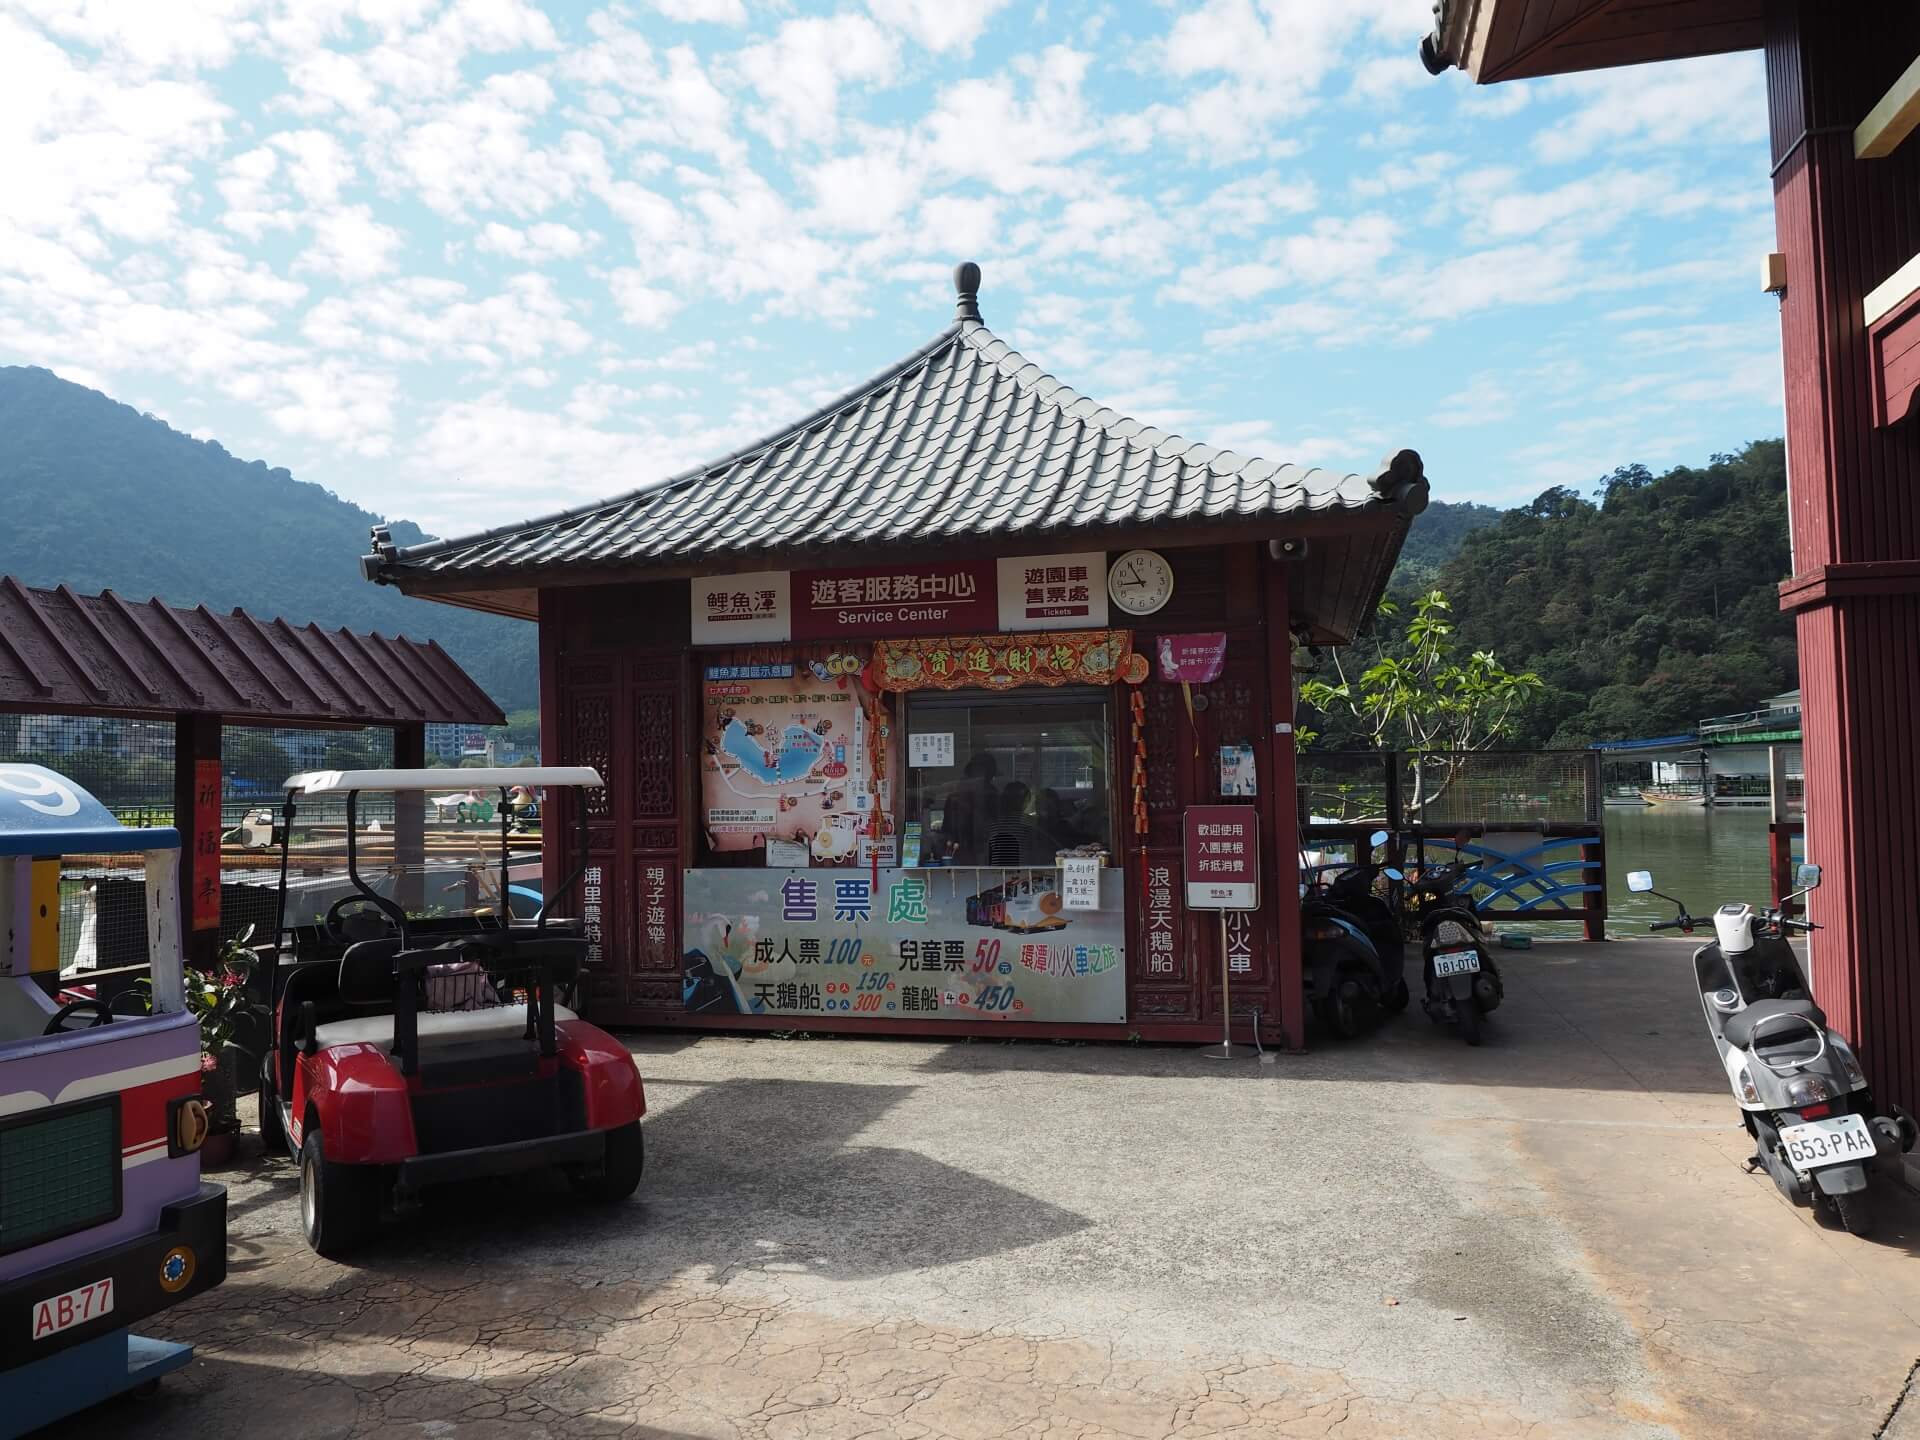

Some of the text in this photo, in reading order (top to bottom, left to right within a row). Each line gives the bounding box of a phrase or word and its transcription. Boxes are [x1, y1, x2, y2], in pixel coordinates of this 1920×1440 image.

[811, 573, 976, 604] 遊客服務中心
[1024, 566, 1088, 585] 遊園車
[707, 590, 776, 613] 鯉魚潭
[1025, 586, 1089, 605] 售票處
[838, 608, 949, 624] Service Center
[1042, 607, 1072, 616] Tickets
[1197, 823, 1243, 836] 歡迎使用
[1197, 842, 1244, 855] 入園票根
[1197, 859, 1244, 873] 折抵消費
[780, 877, 928, 924] 售票處
[583, 866, 602, 962] 埔里農特產
[1148, 866, 1174, 973] 浪漫天鵝船
[754, 938, 821, 965] 成人票
[898, 939, 966, 973] 兒童票
[1020, 943, 1119, 978] 環潭小火車之旅
[754, 983, 821, 1010] 天鵝船
[901, 985, 938, 1011] 龍船
[35, 1280, 112, 1337] AB-77
